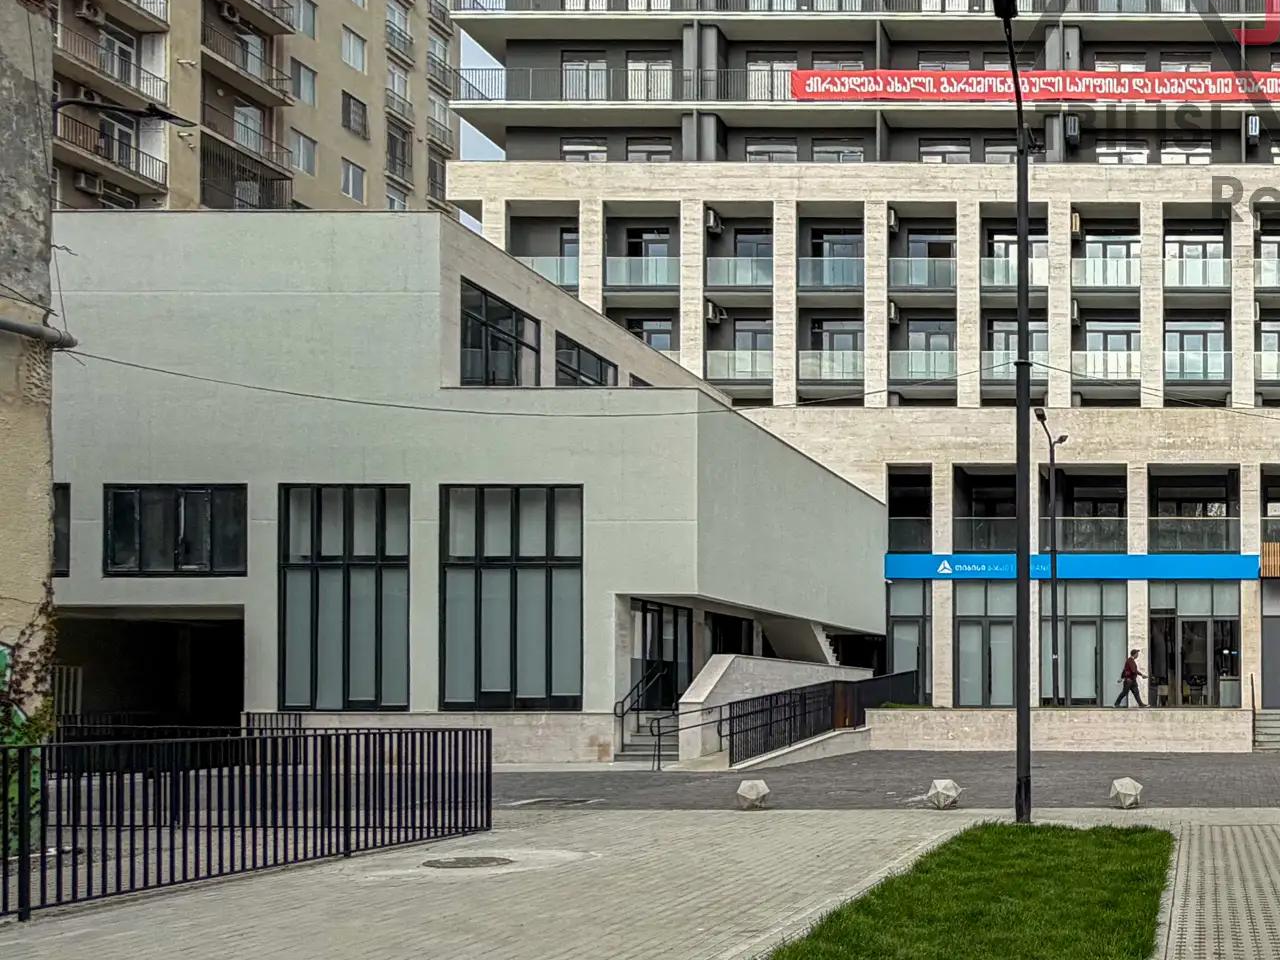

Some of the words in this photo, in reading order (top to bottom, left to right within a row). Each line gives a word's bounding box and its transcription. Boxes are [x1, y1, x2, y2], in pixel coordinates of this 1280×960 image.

[805, 76, 883, 93] ქირავდება
[940, 76, 1063, 93] გარემონტბული
[1066, 77, 1129, 94] საოფისე
[1132, 77, 1151, 94] და
